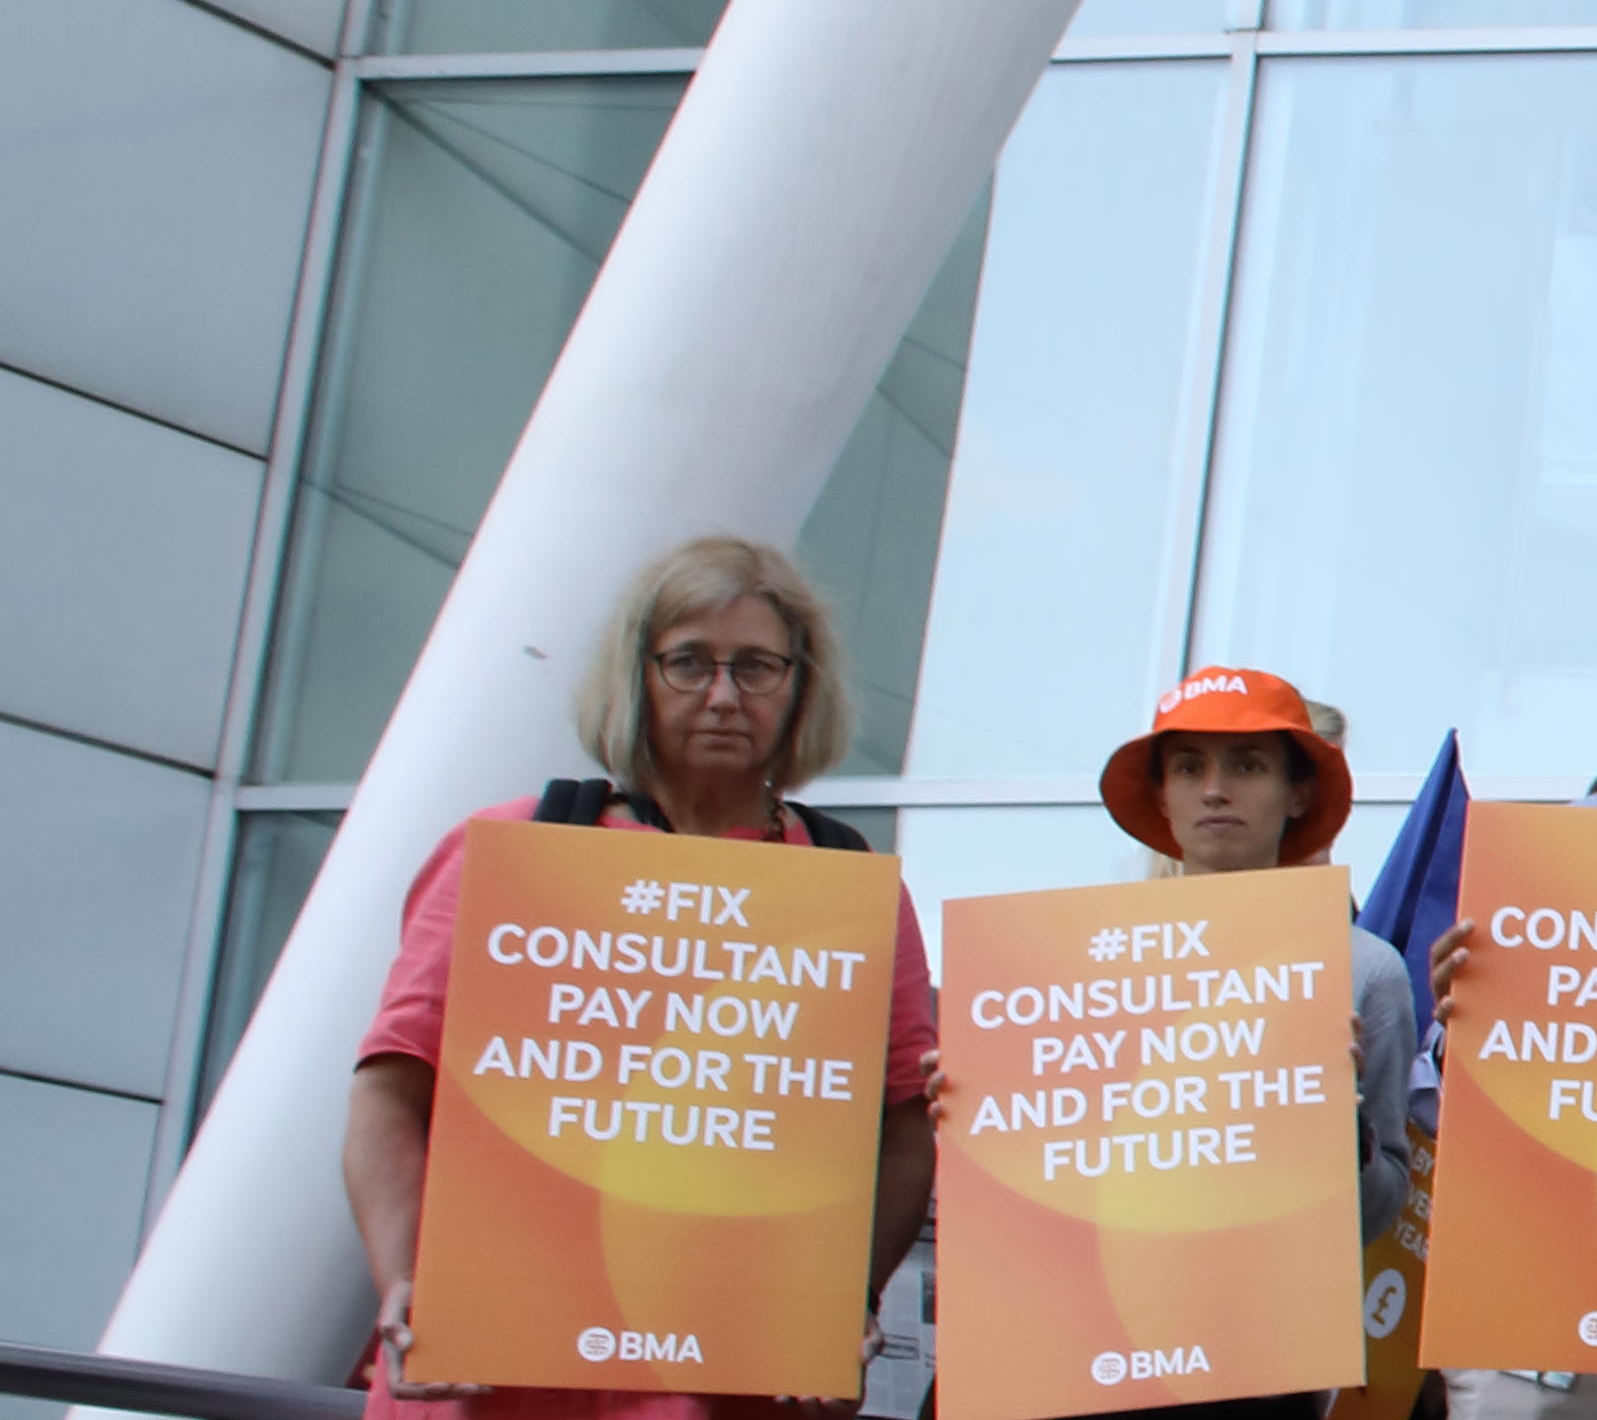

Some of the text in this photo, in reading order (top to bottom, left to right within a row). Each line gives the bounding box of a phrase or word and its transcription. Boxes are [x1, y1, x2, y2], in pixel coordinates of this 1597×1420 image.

[1183, 674, 1248, 701] BMA
[620, 879, 752, 928] #FIX
[487, 922, 867, 991] CONSULTANT
[1087, 919, 1211, 964] #FIX
[548, 983, 800, 1041] PAY NOW
[970, 960, 1326, 1031] CONSULTANT
[473, 1035, 854, 1101] AND FOR THE
[1032, 1016, 1267, 1077] PAY NOW
[548, 1096, 777, 1152] FUTURE
[969, 1064, 1328, 1137] AND FOR THE
[1042, 1123, 1259, 1181] FUTURE
[1395, 1218, 1428, 1261] YEA
[618, 1330, 704, 1363] BMA
[1128, 1344, 1212, 1381] BMA
